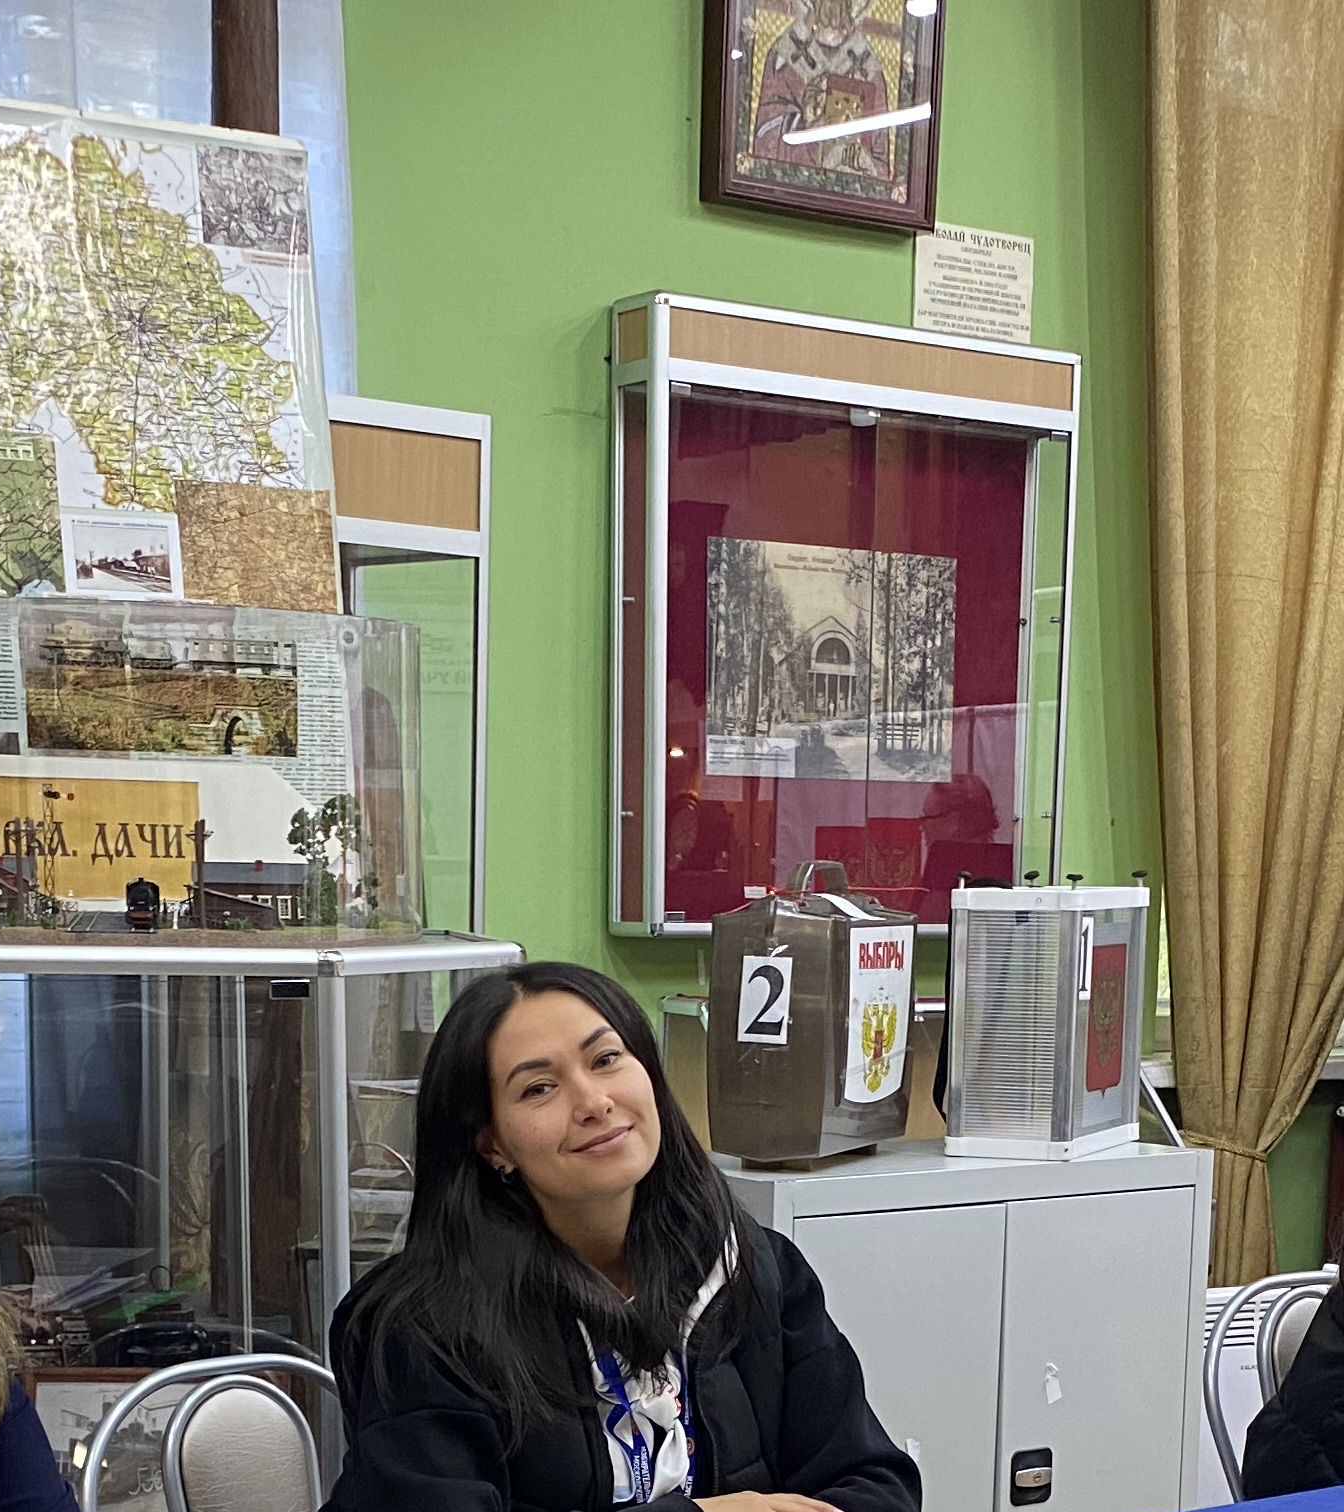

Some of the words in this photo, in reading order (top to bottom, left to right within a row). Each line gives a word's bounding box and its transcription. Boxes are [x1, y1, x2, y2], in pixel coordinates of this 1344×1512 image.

[91, 822, 186, 866] ДАЧИ
[859, 940, 905, 971] ВЫБОРЫ
[1079, 924, 1090, 993] 1
[743, 965, 786, 1036] 2
